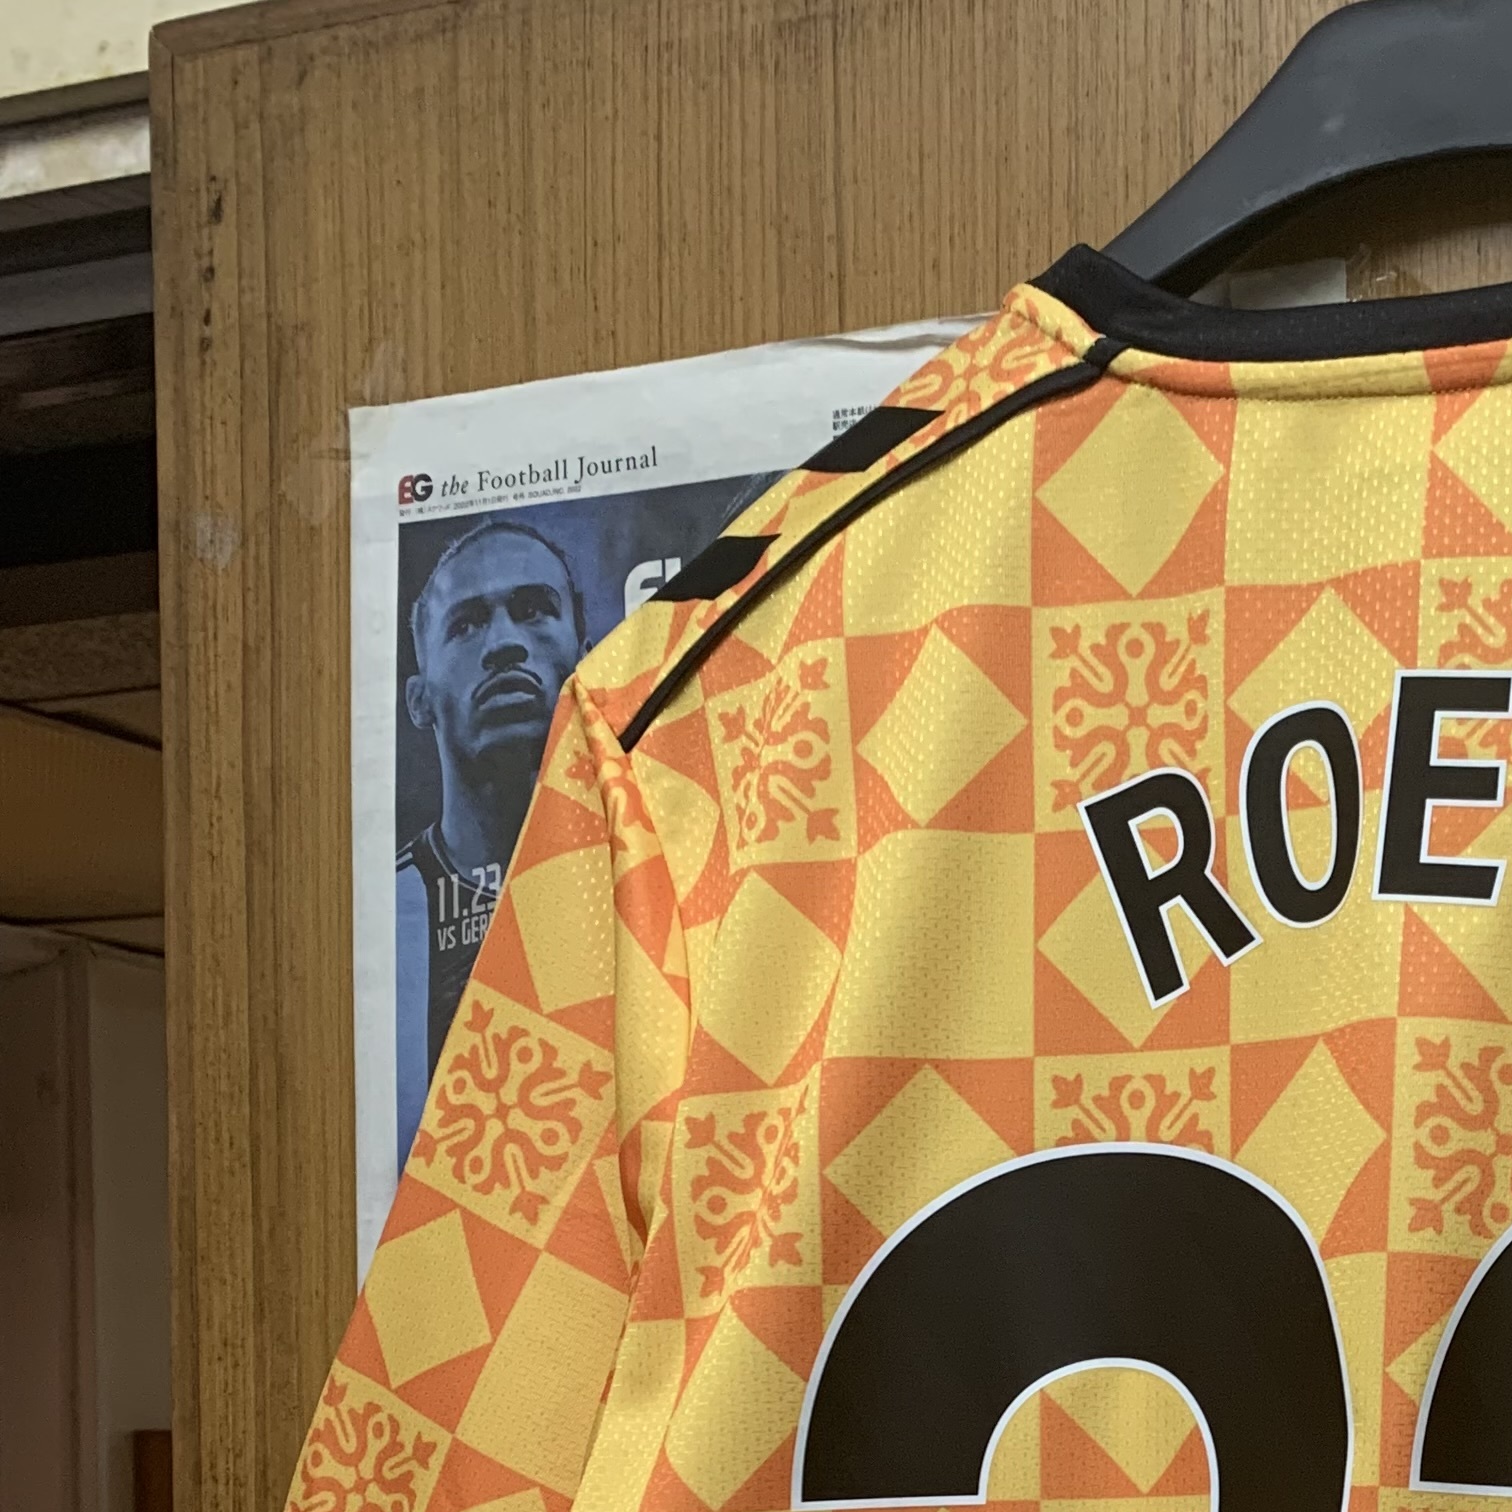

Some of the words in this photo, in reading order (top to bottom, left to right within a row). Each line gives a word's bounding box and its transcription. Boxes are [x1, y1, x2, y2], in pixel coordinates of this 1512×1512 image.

[398, 473, 434, 505] EG
[441, 475, 469, 498] the
[477, 459, 568, 493] Football
[574, 445, 657, 484] Journal
[437, 863, 501, 922] 11.23
[437, 925, 456, 951] VS
[462, 911, 493, 945] GER
